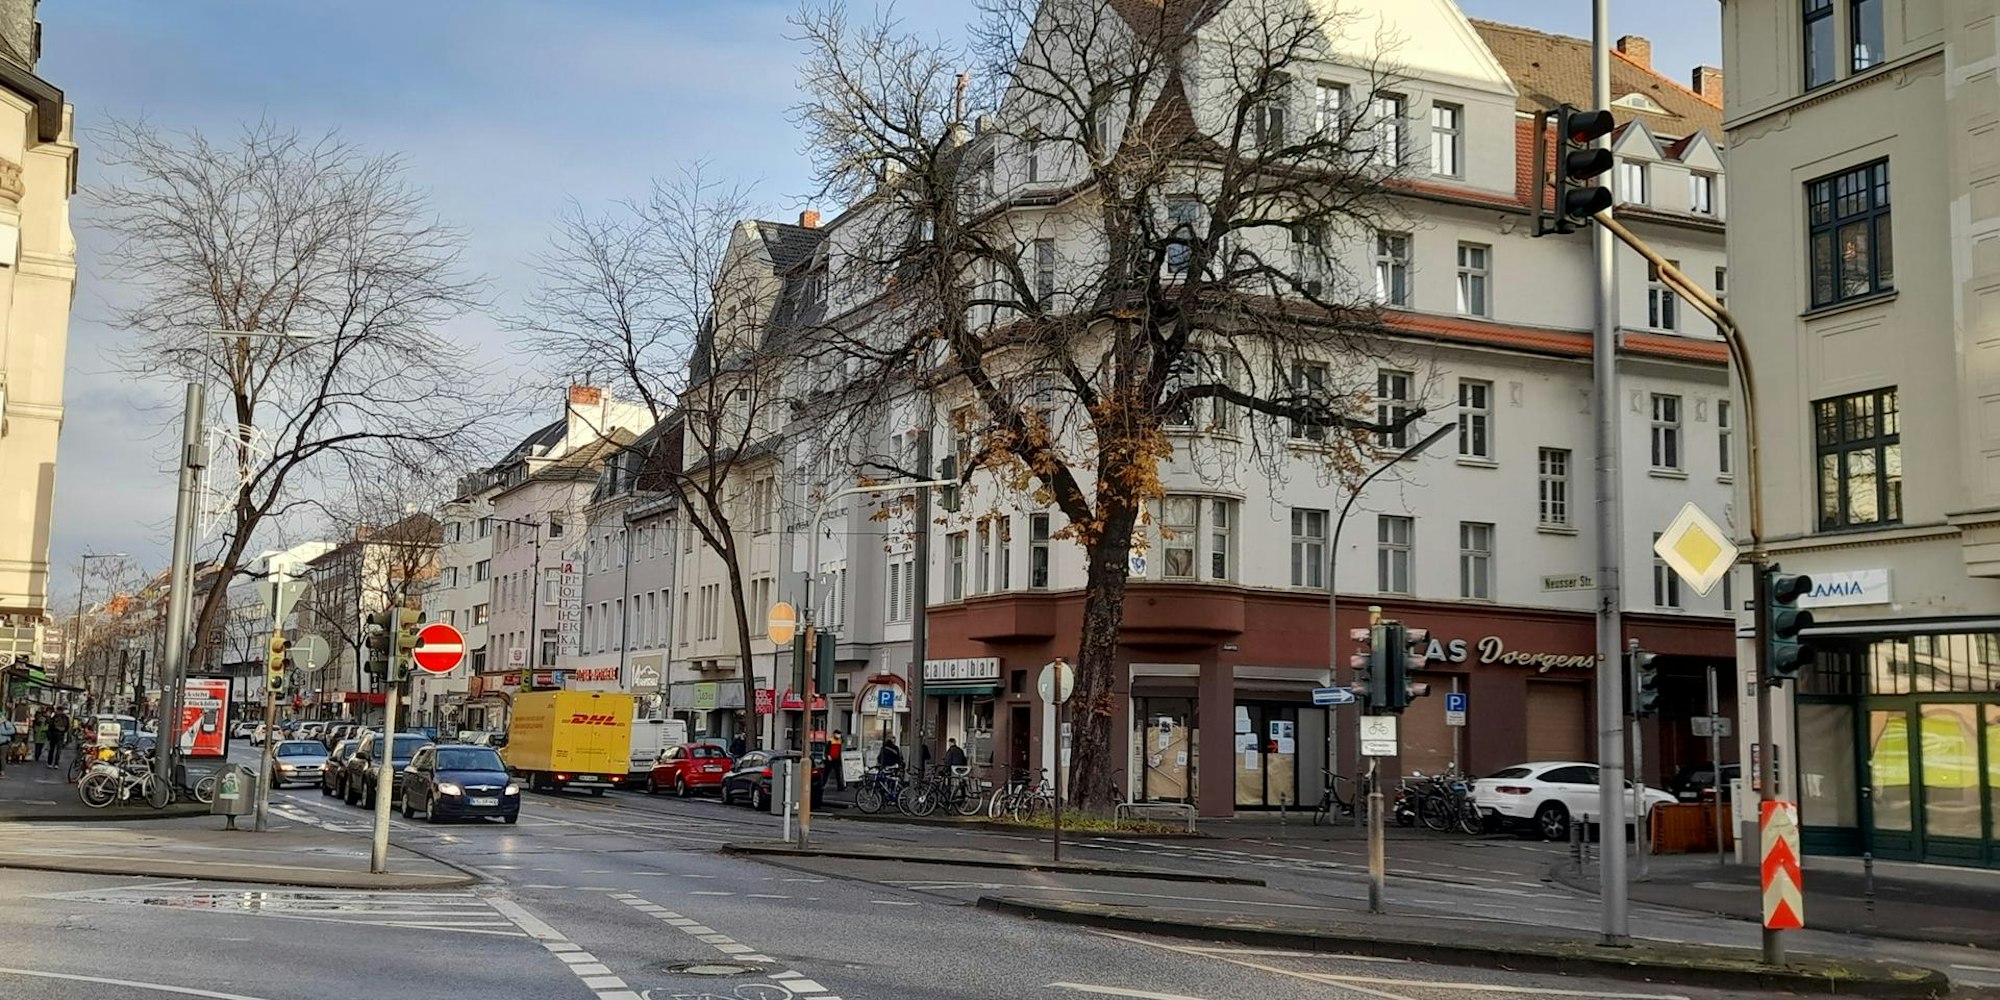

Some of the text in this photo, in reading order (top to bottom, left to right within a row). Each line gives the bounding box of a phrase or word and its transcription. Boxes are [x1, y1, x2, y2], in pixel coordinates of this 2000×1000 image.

[1544, 575, 1594, 589] Neusser Str.
[1409, 638, 1468, 662] LAS
[881, 692, 891, 704] P
[1450, 696, 1461, 710] P
[571, 713, 617, 726] DHL
